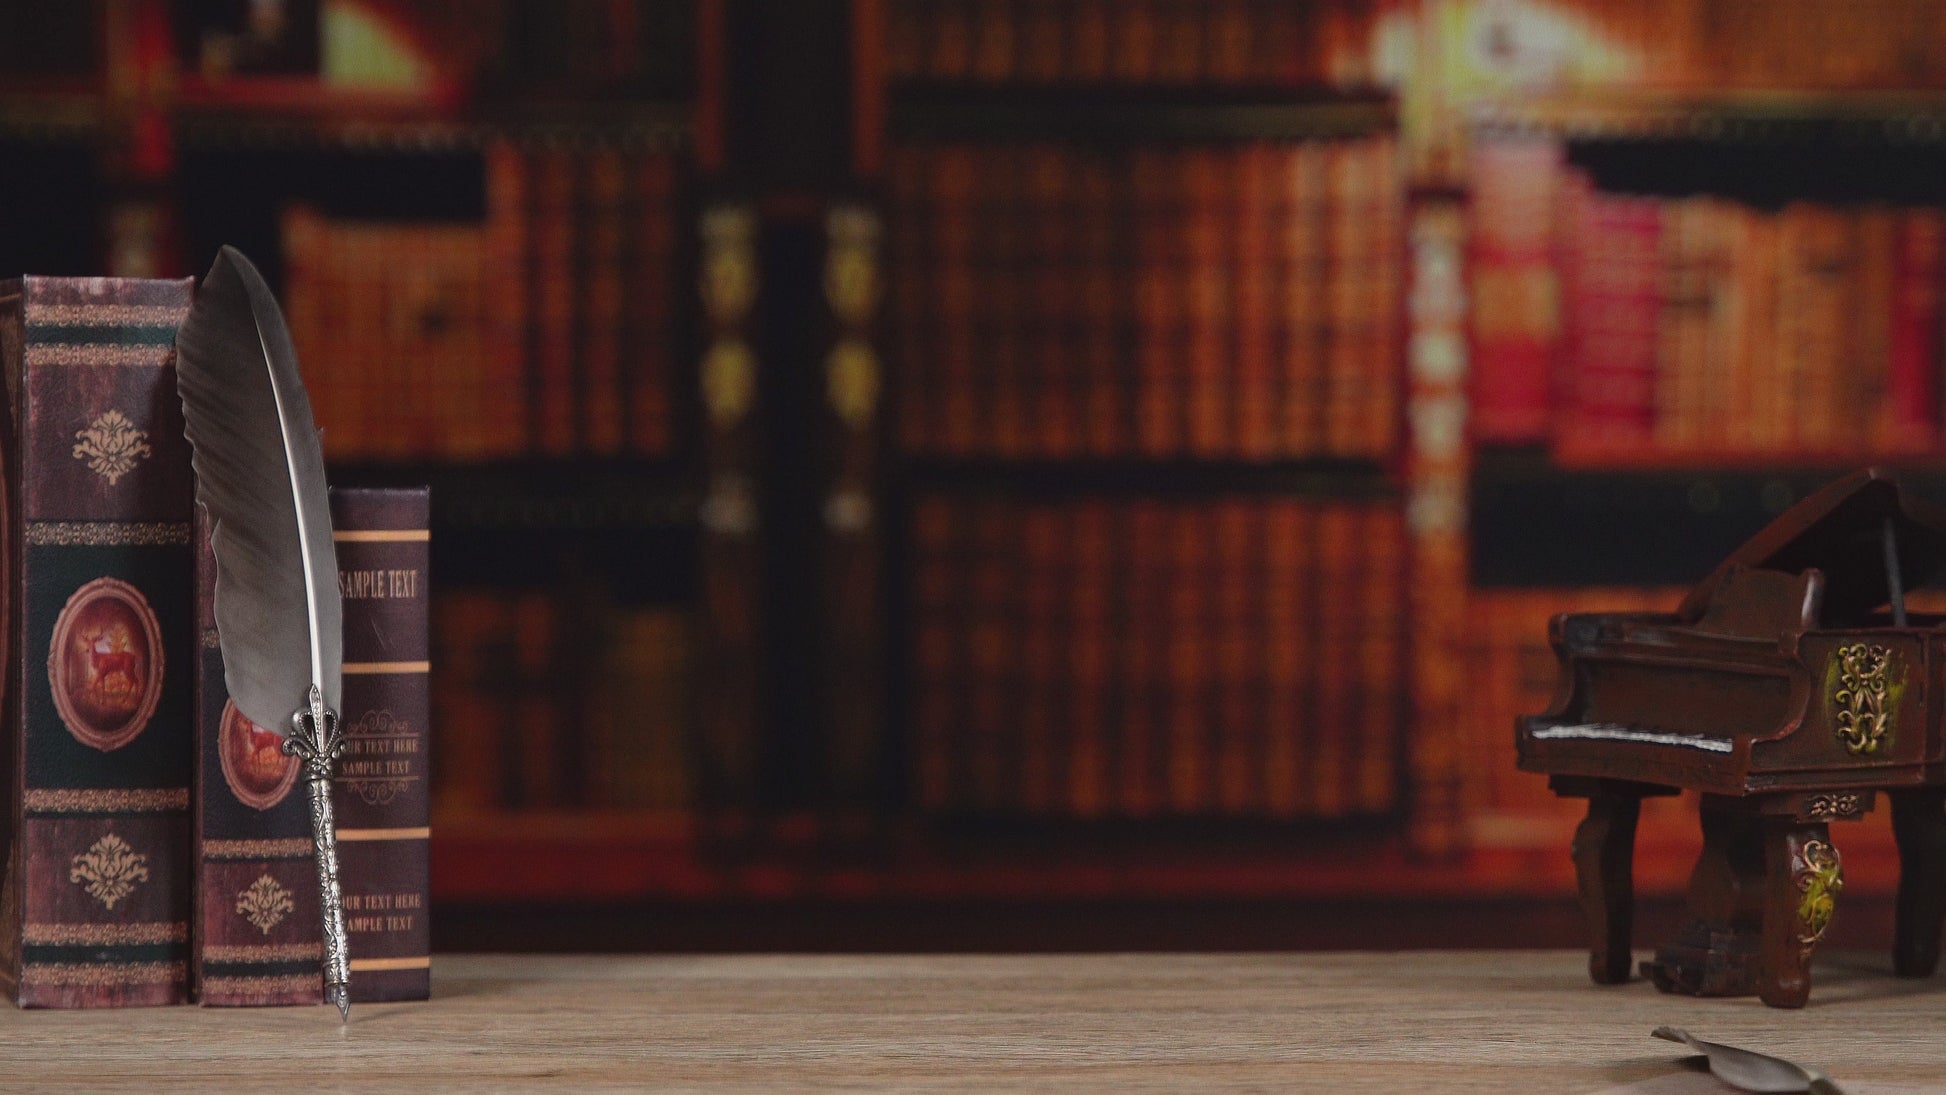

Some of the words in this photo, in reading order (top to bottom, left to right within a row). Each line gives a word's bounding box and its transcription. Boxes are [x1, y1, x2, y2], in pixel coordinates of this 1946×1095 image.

[339, 570, 384, 598] SAMPLE
[388, 569, 417, 598] TEXT
[365, 740, 390, 753] TEXT
[393, 739, 418, 753] HERE
[342, 761, 382, 775] SAMPLE
[386, 760, 410, 774] TEXT
[365, 894, 392, 910] TEXT
[395, 892, 421, 909] HERE
[346, 916, 383, 932] AMPLE
[386, 915, 413, 931] TEXT
